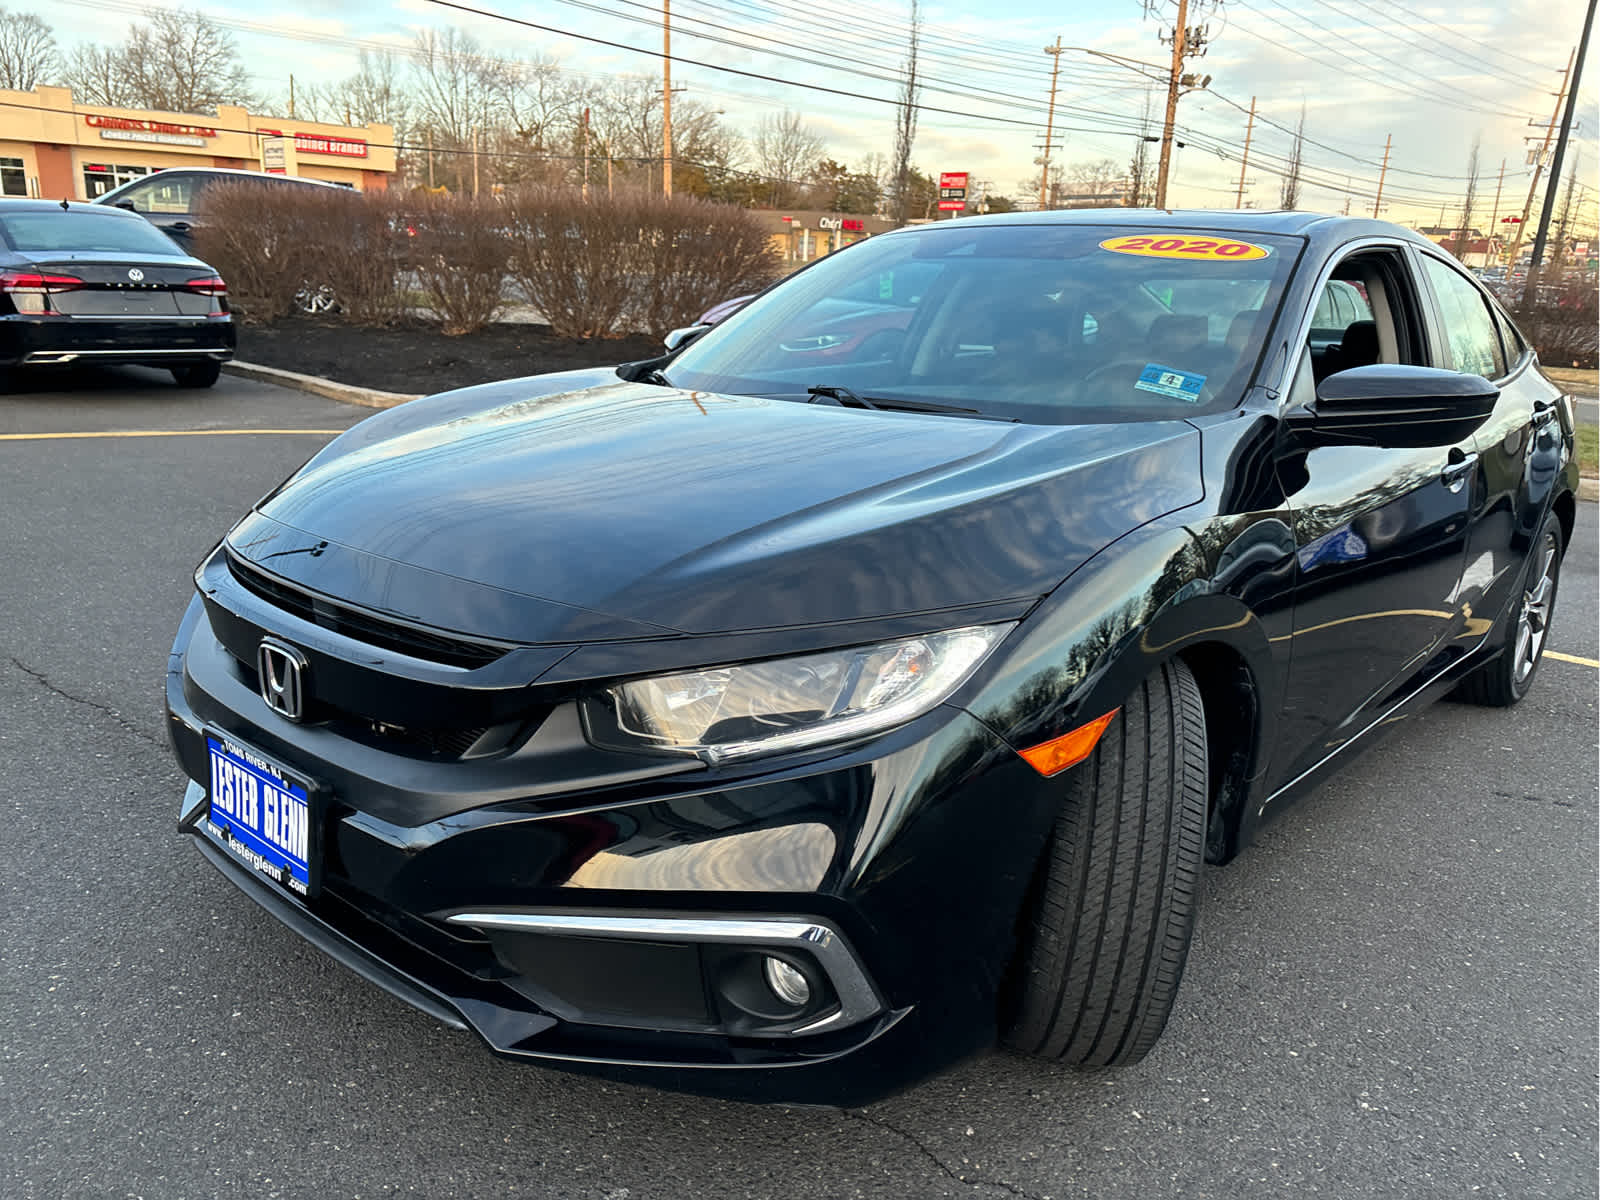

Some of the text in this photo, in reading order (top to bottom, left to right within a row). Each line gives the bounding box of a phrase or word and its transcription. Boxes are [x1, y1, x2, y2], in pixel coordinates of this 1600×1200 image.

[295, 136, 329, 151] abinet
[1114, 238, 1251, 256] 2020
[1165, 375, 1176, 385] 4
[223, 739, 245, 760] TOMS
[270, 765, 282, 780] NJ
[211, 753, 309, 863] LESTER GLENN
